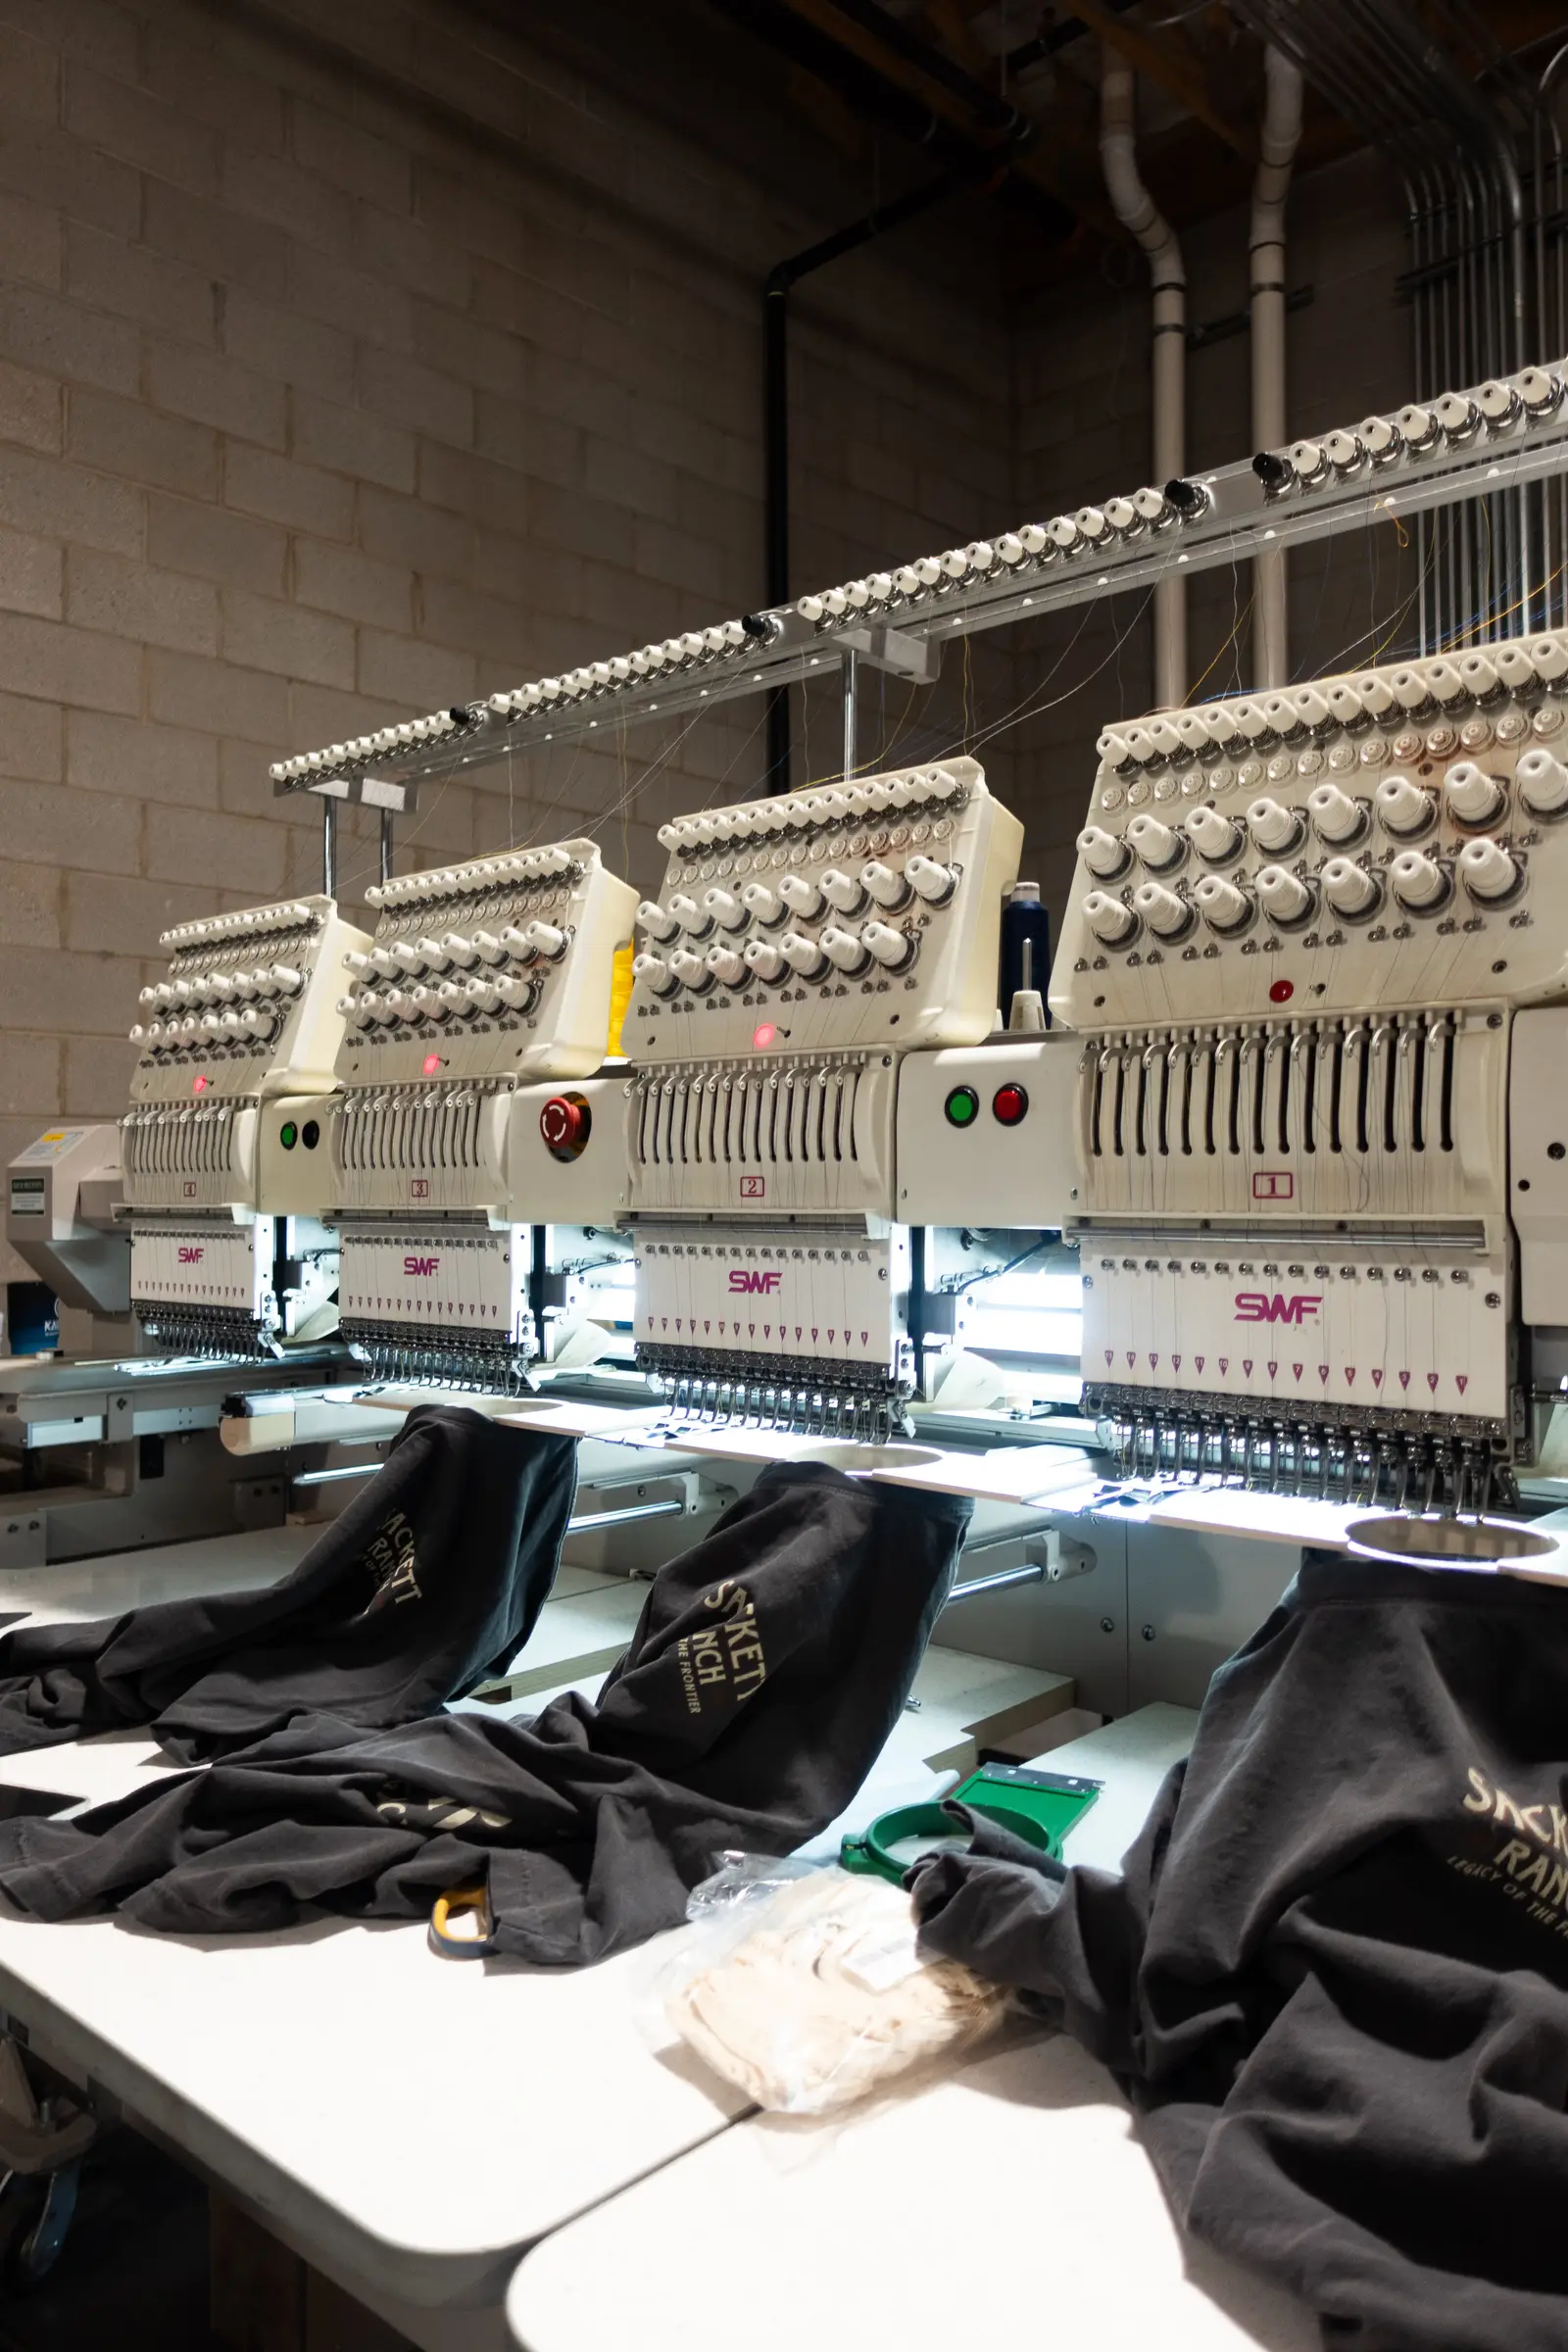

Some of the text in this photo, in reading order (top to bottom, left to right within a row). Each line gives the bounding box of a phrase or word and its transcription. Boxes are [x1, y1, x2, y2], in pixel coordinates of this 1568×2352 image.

[416, 1182, 423, 1196] 3
[748, 1179, 757, 1194] 2
[1266, 1176, 1278, 1195] 1
[178, 1247, 204, 1263] SWF
[404, 1256, 440, 1277] SWF
[728, 1270, 783, 1295] SWF
[1234, 1293, 1323, 1324] SWF
[692, 1631, 727, 1685] NCH
[679, 1660, 702, 1714] FRONTIER
[1494, 1838, 1568, 1906] RAN
[1446, 1854, 1502, 1882] LEGACY
[1502, 1883, 1528, 1900] OF
[1526, 1900, 1559, 1925] THE
